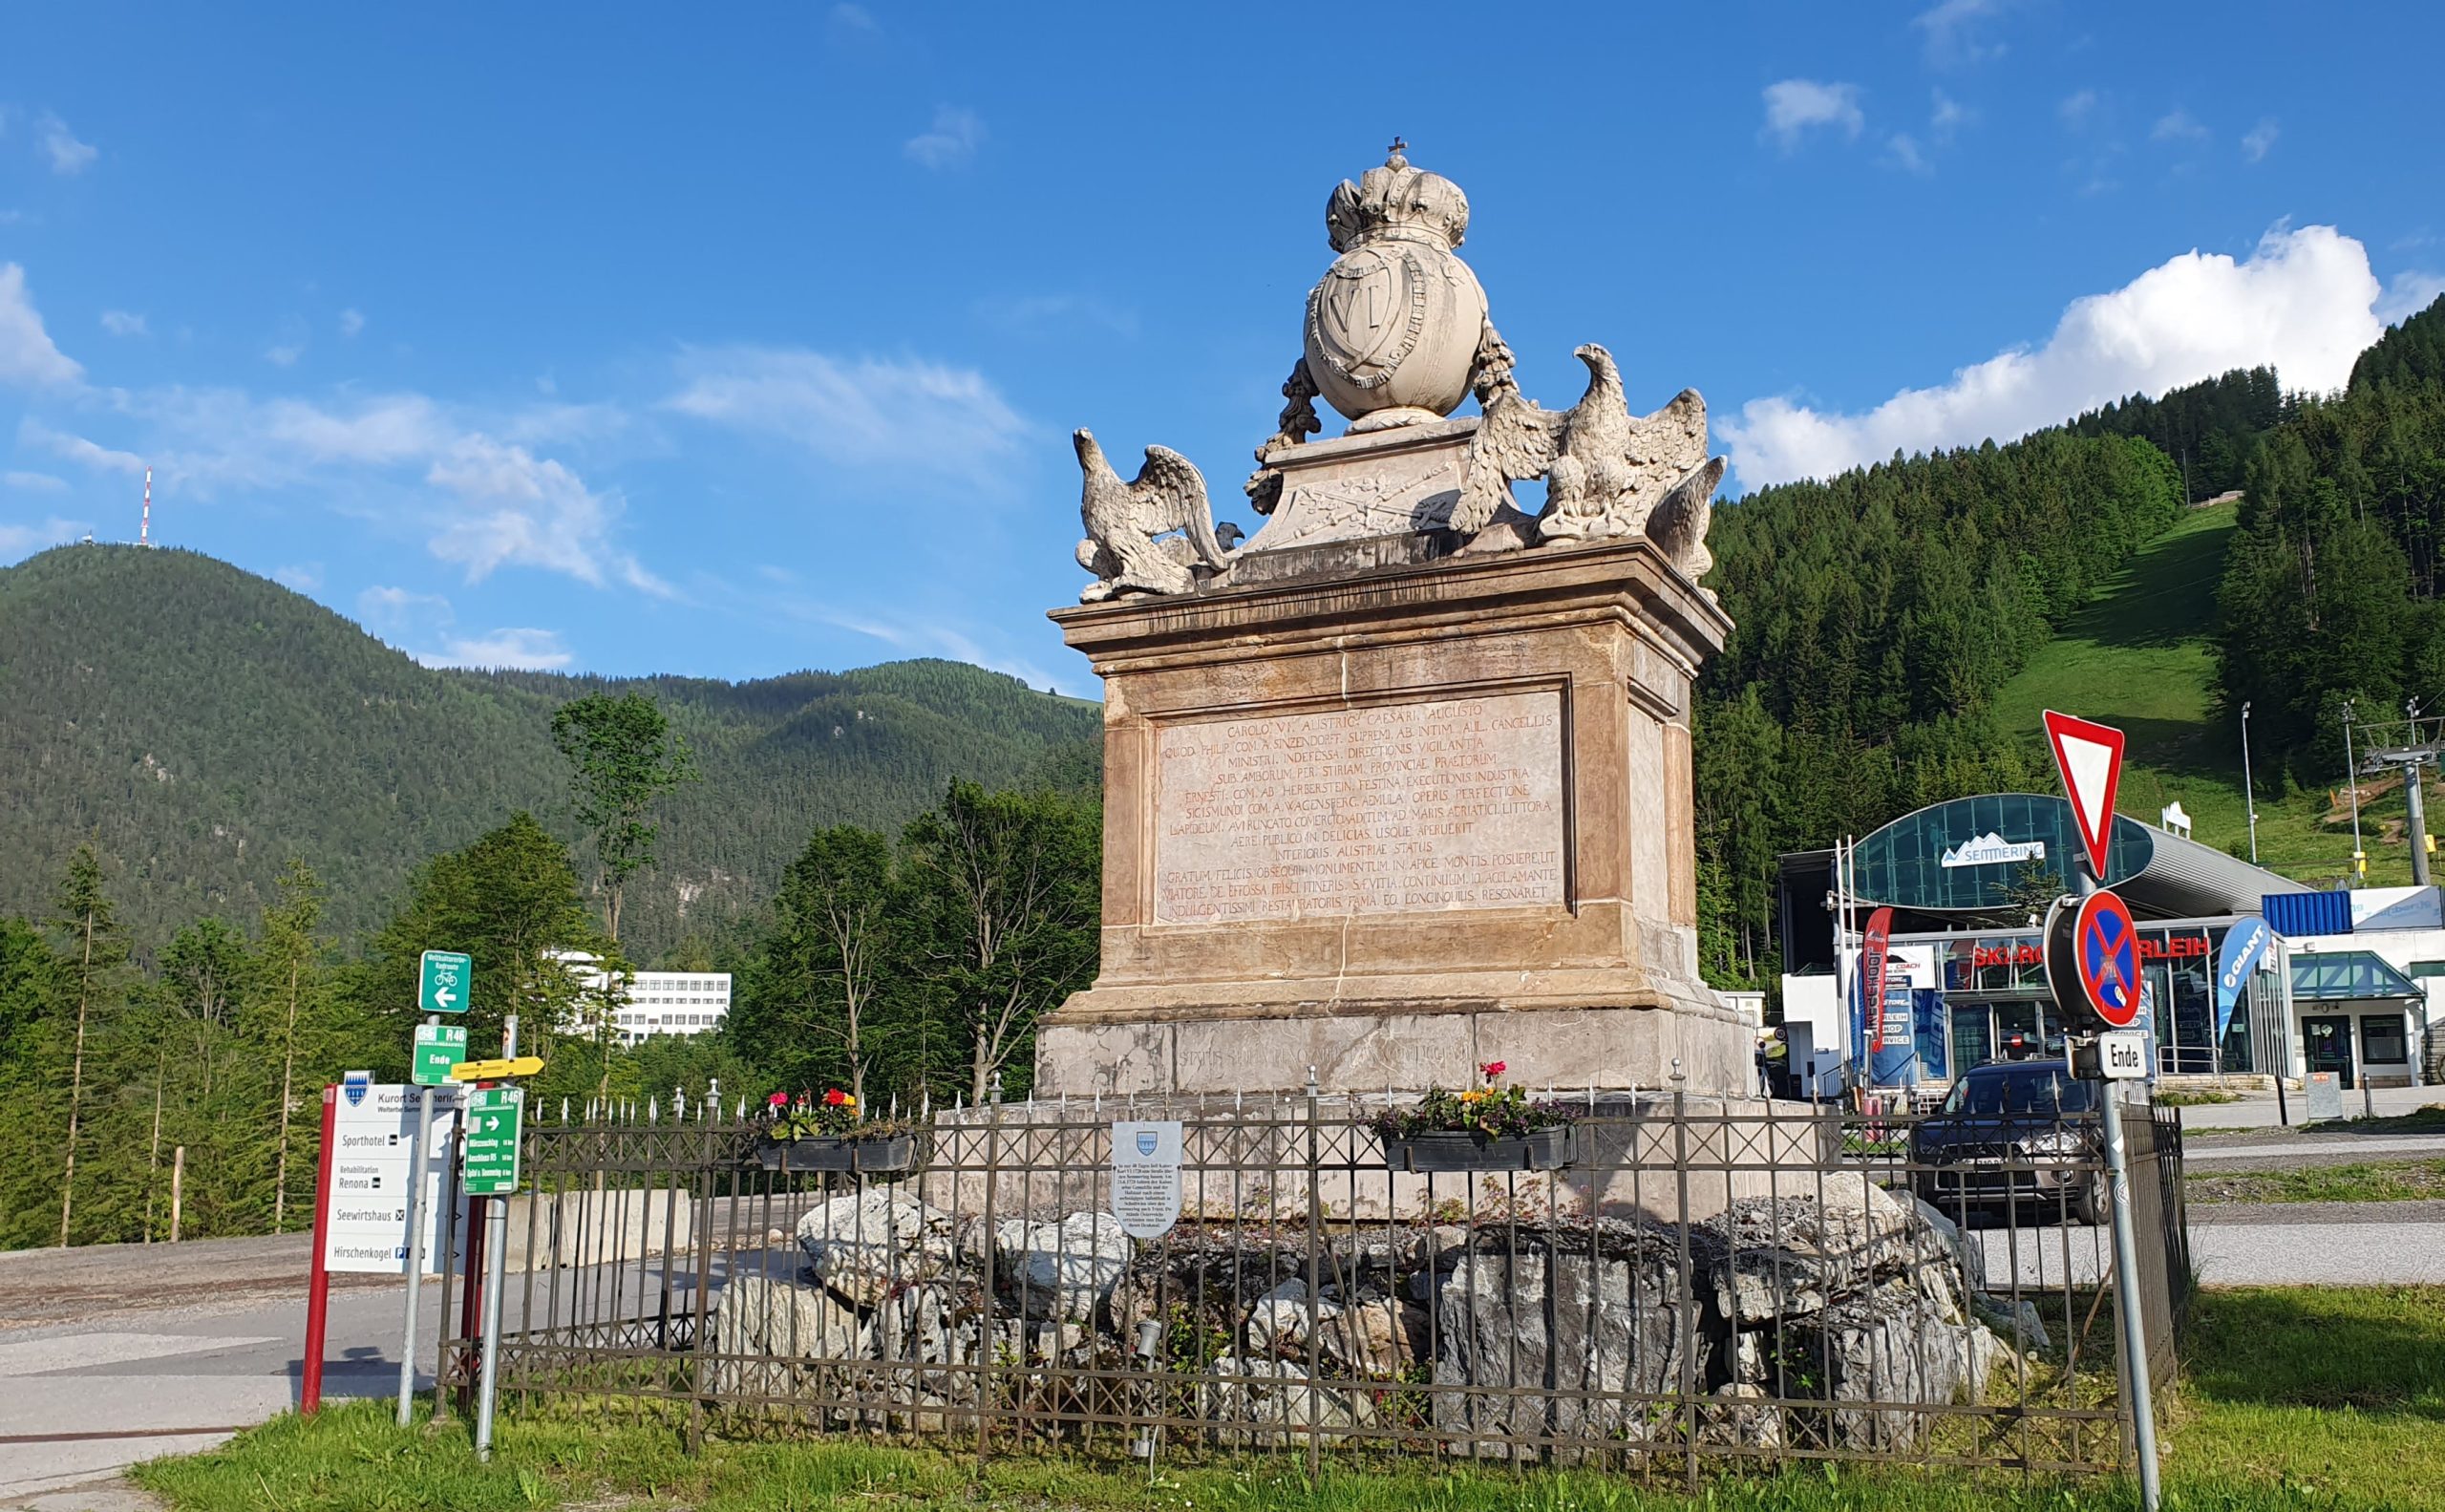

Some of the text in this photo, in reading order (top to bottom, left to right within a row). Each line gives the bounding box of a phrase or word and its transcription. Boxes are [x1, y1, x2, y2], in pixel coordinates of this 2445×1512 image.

[1965, 844, 2043, 862] SEMMERING
[2232, 925, 2264, 975] GIANT
[429, 1054, 451, 1065] Ende
[2111, 1044, 2138, 1067] Ende
[377, 1093, 407, 1103] Kurort
[342, 1135, 385, 1148] Sporthotel
[340, 1165, 379, 1174] Rehabilitation
[339, 1178, 369, 1189] Renona
[336, 1209, 392, 1222] Seewirtshaus
[334, 1246, 392, 1262] Hirschenkogel
